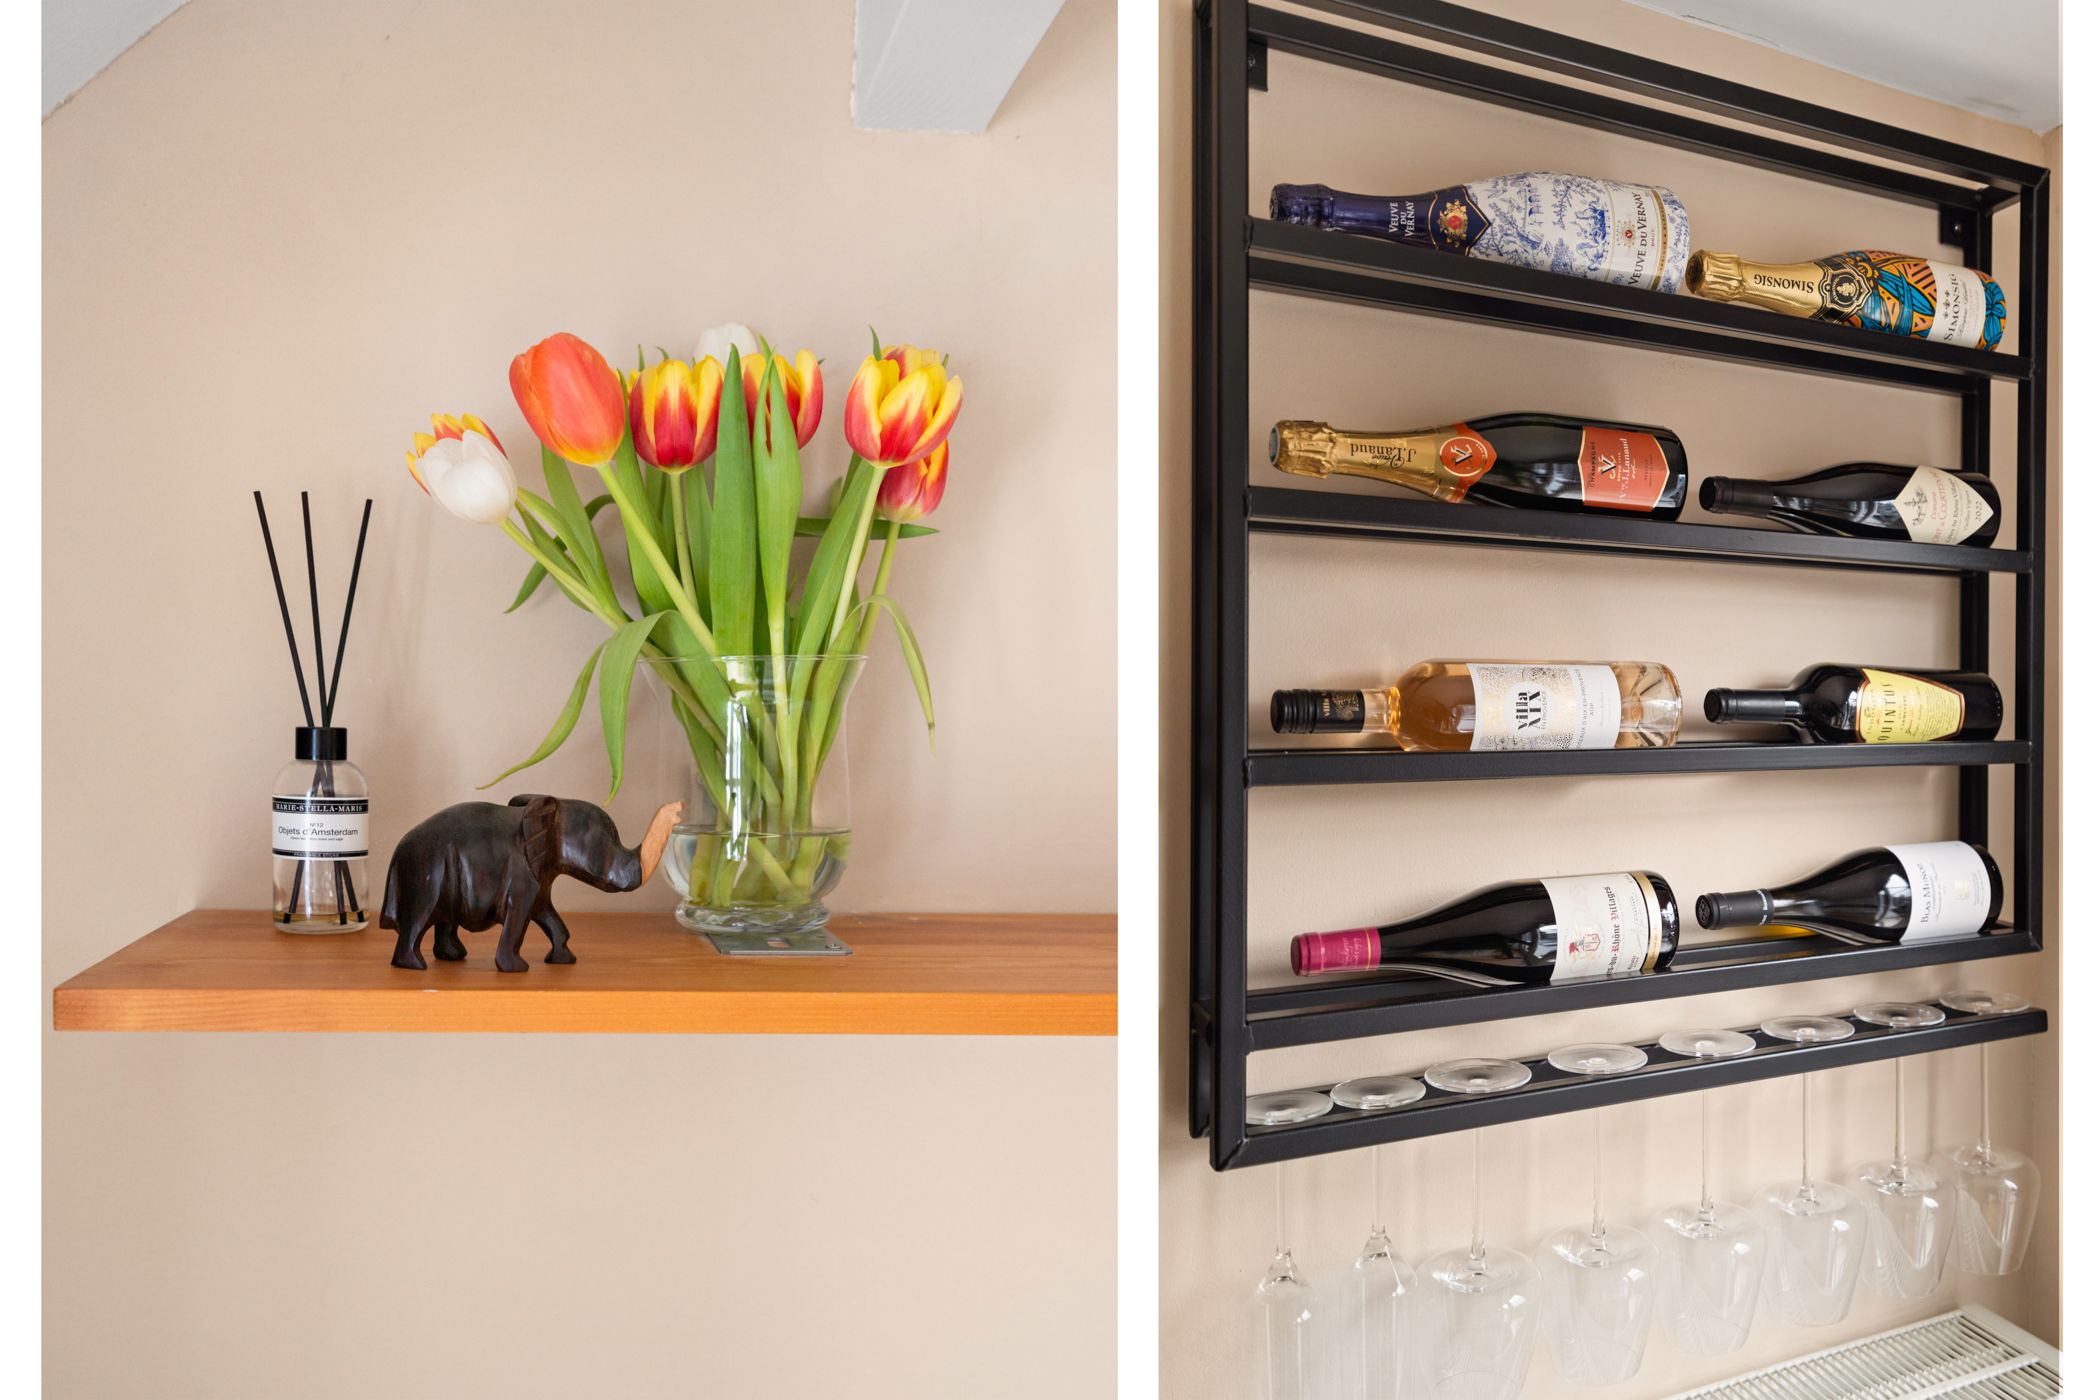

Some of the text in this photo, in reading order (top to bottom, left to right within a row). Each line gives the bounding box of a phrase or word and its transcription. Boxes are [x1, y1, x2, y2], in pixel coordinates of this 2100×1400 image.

[1389, 202, 1398, 233] VEUVE
[1400, 212, 1406, 224] DU
[1405, 201, 1414, 236] VERNAY
[1628, 192, 1648, 285] VEUVE DU VERNAY
[1754, 274, 1814, 293] SIMONSIG
[1944, 274, 1959, 340] SIMONSIG
[1516, 692, 1528, 730] villa
[1528, 691, 1541, 730] AIX
[1878, 684, 1896, 741] QUINTUS
[278, 826, 301, 837] Objets
[1604, 887, 1618, 920] Villages
